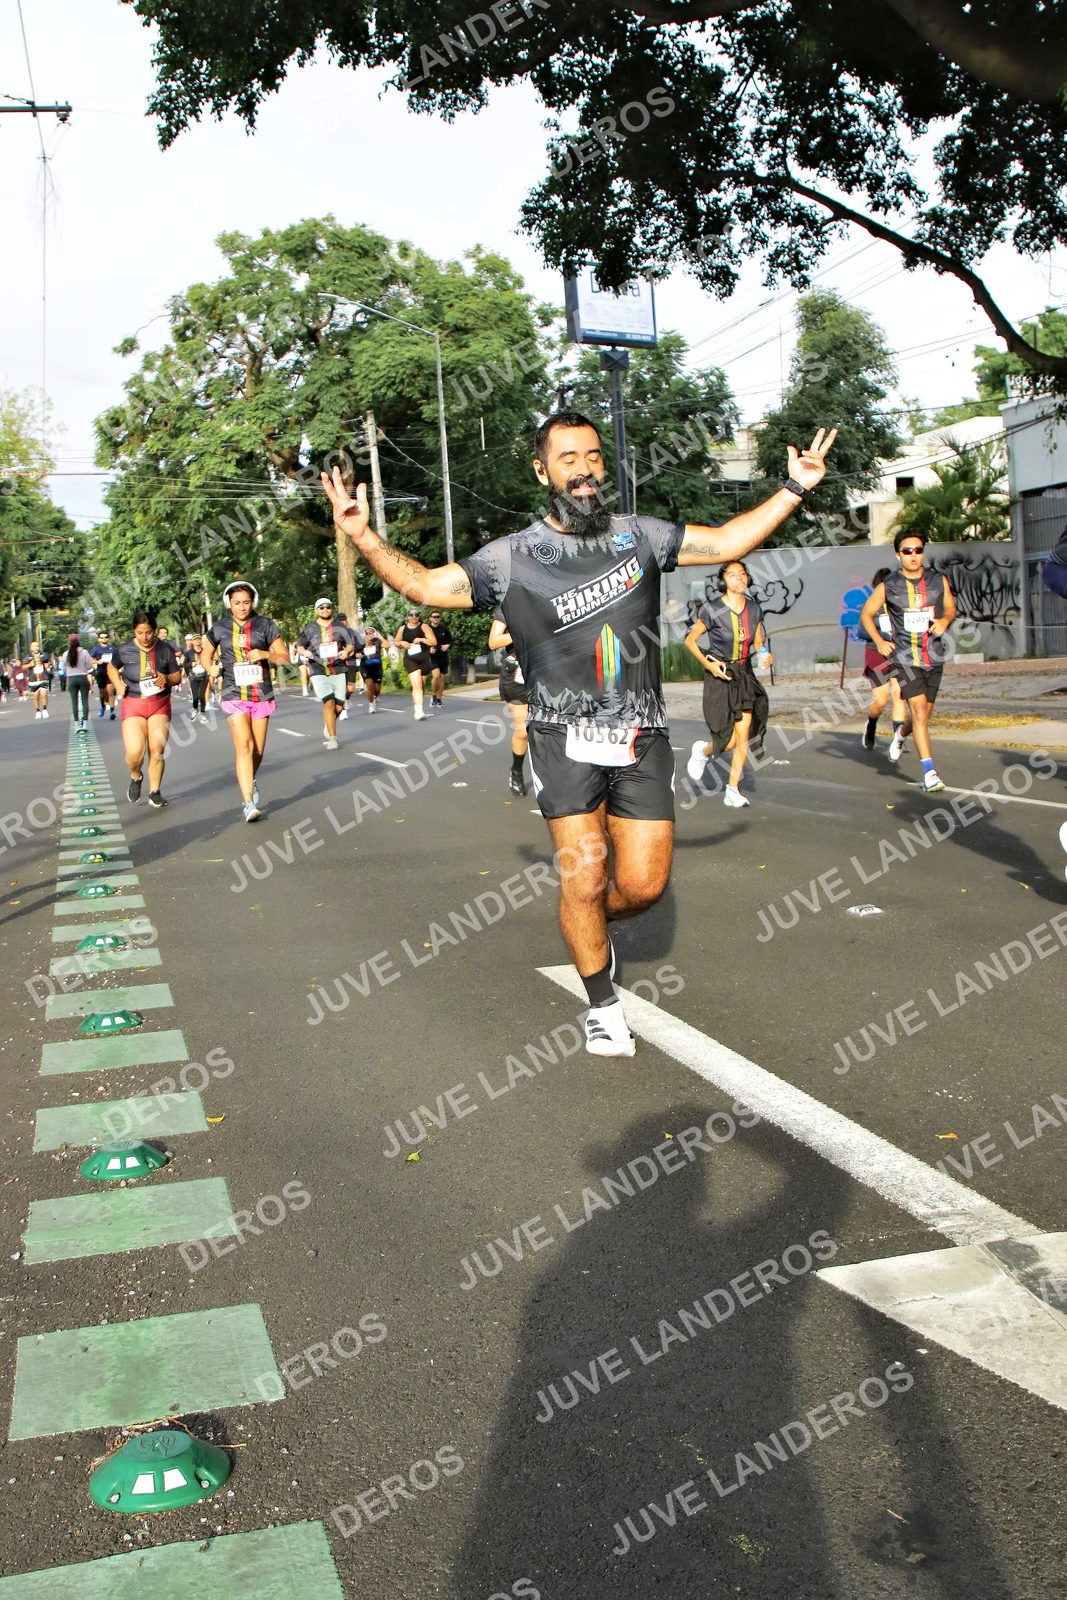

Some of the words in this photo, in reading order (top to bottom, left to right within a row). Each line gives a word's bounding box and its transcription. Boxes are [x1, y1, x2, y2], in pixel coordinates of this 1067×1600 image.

[550, 588, 578, 607] THE
[555, 556, 642, 620] HIKING
[561, 583, 628, 625] RUNNERS
[575, 727, 629, 745] 10562
